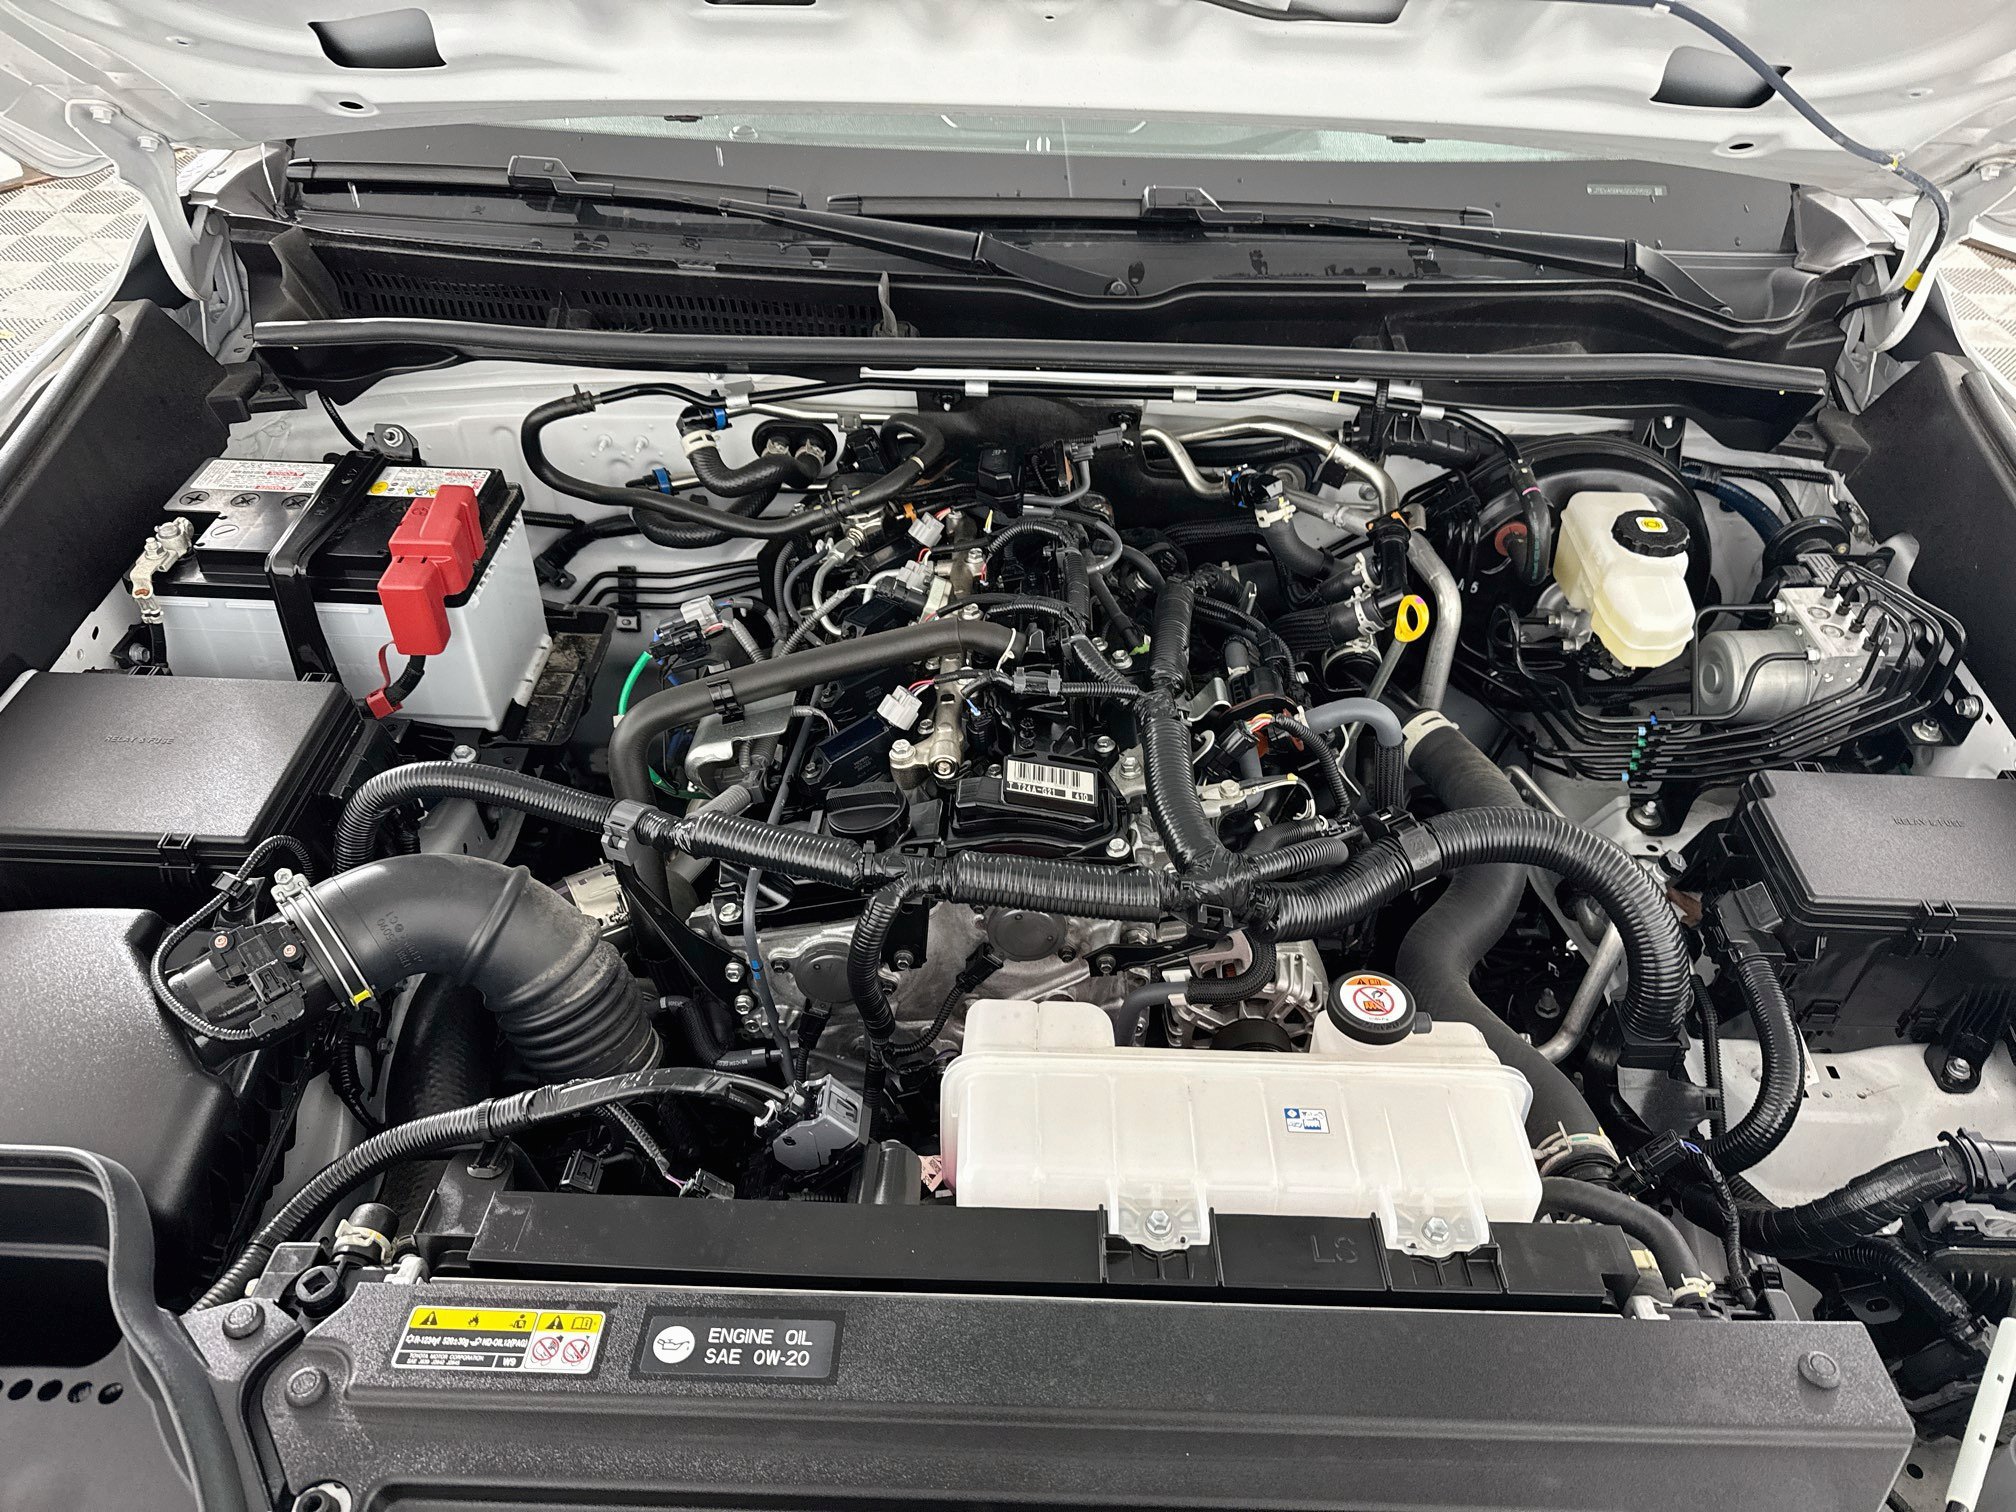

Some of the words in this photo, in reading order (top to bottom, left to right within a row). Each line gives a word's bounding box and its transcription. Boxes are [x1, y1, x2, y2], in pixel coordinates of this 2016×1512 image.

[1310, 1234, 1359, 1264] LS
[707, 1327, 775, 1345] ENGINE
[784, 1329, 813, 1346] OIL
[502, 1357, 517, 1367] W9
[703, 1347, 743, 1365] SAE
[753, 1349, 810, 1367] 0W-20
